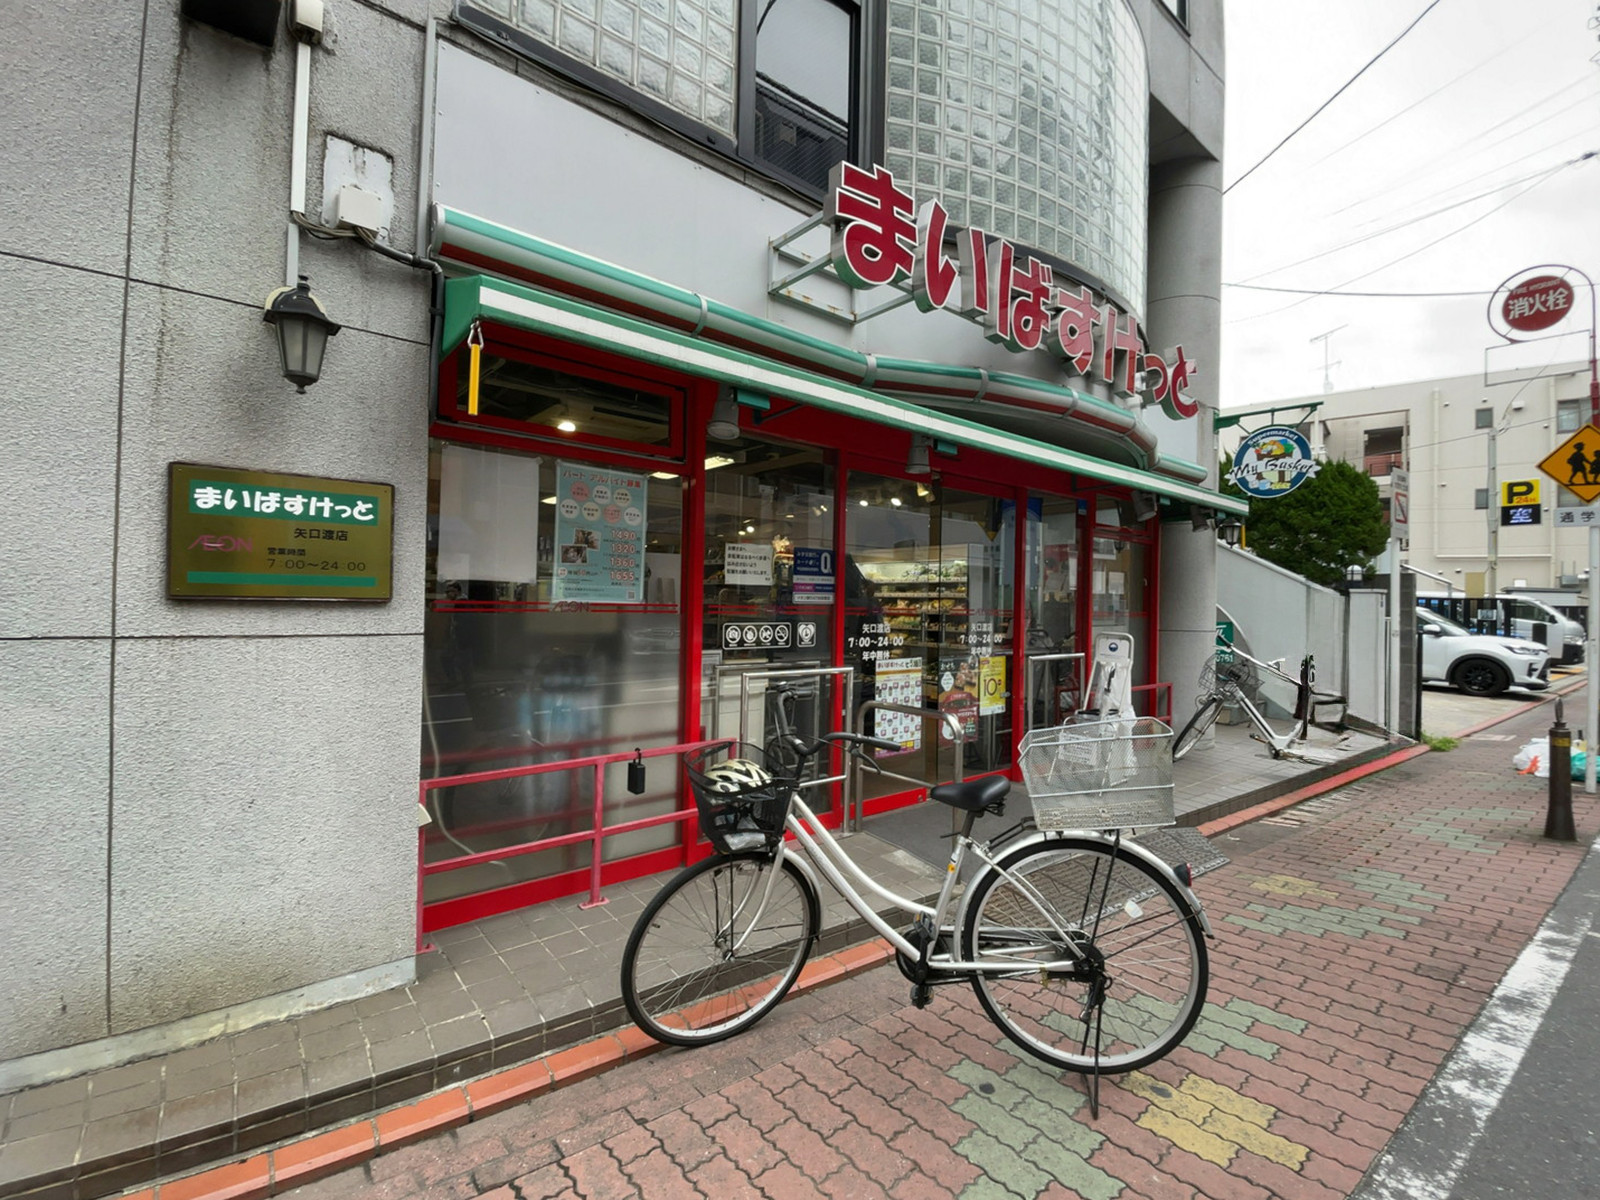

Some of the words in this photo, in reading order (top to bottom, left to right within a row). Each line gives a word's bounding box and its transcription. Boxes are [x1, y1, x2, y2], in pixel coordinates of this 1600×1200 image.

[833, 160, 1200, 421] まいばすけっと
[1512, 286, 1528, 295] FIRE
[1507, 287, 1569, 320] 消火栓
[1247, 429, 1298, 445] Supermarket
[1229, 463, 1258, 478] My
[1265, 457, 1313, 475] Basket
[1506, 481, 1534, 504] P
[1514, 496, 1537, 505] 24H
[193, 486, 375, 522] まいばすけっと
[1509, 507, 1534, 524] 空
[1560, 511, 1596, 524] 通学
[293, 527, 349, 542] 矢口渡店
[267, 547, 306, 556] 営業時間
[862, 623, 891, 634] 矢口渡店
